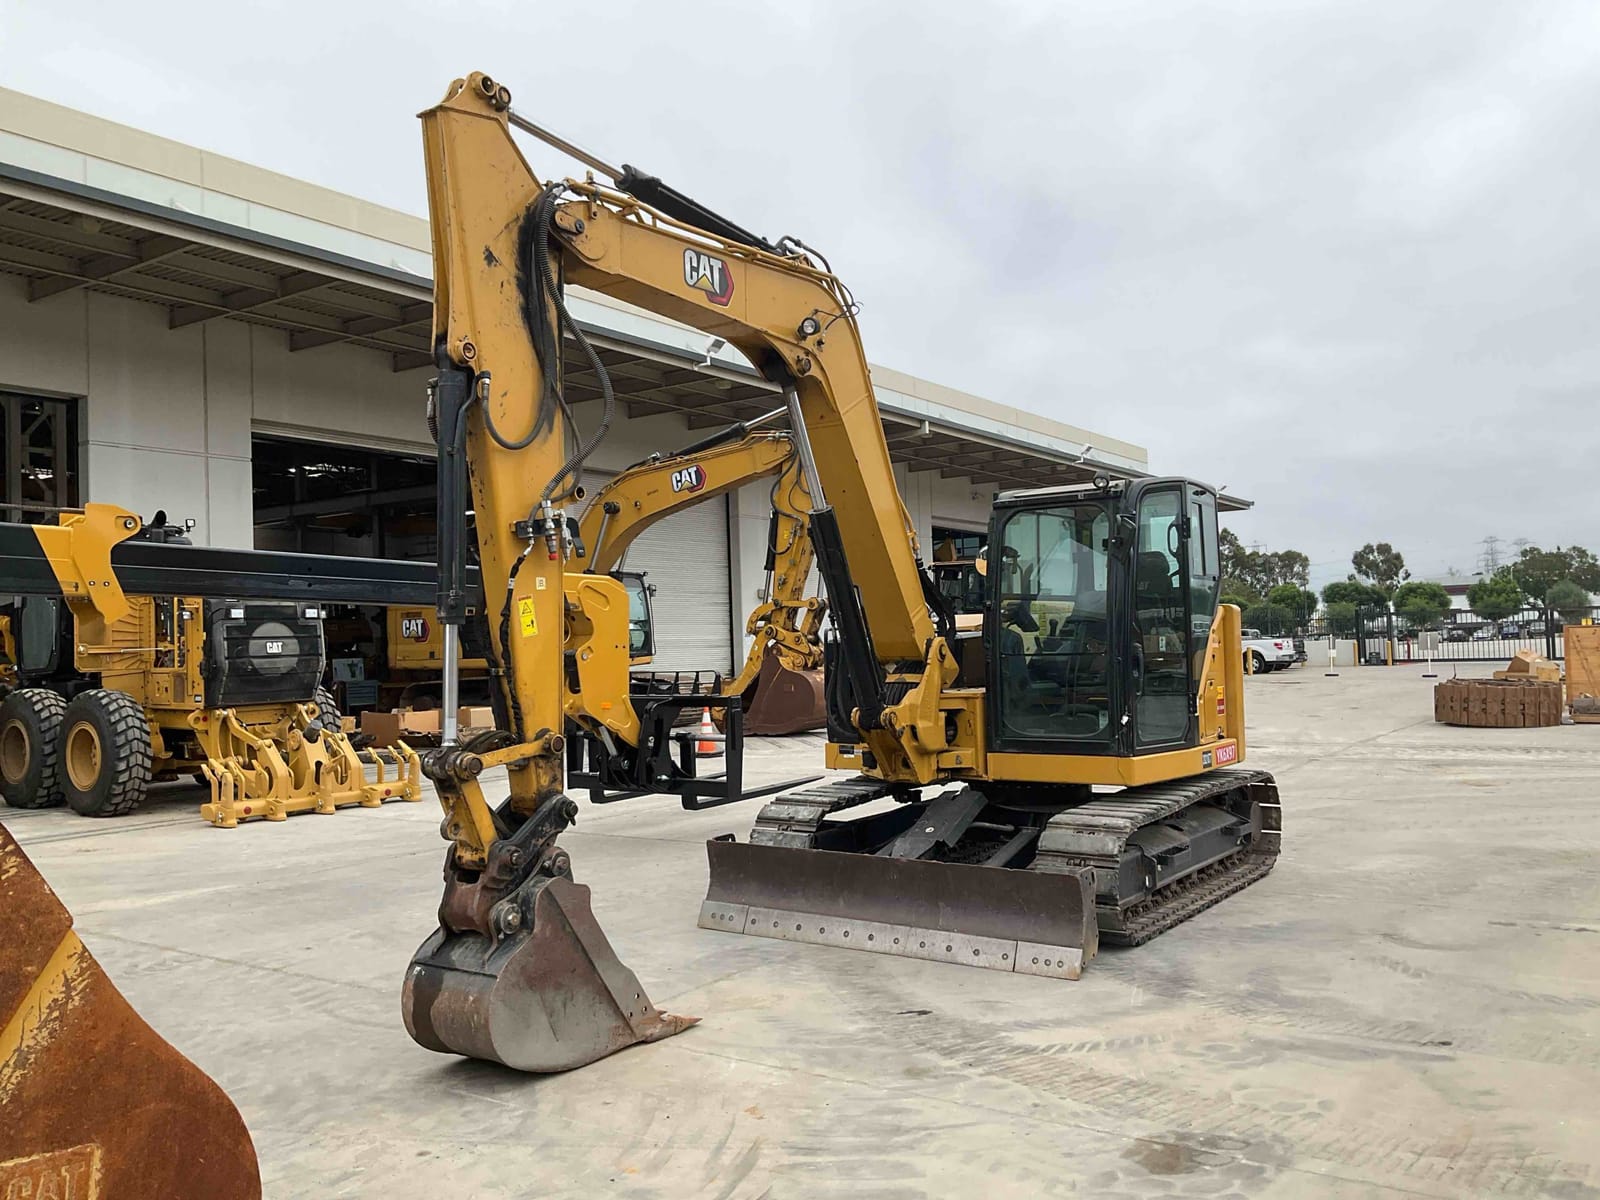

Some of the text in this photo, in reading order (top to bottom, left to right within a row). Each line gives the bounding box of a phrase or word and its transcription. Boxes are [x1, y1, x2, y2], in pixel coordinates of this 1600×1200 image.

[684, 249, 722, 295] CAT
[671, 466, 698, 492] CAT
[402, 619, 424, 638] CAT
[266, 641, 283, 654] CAT
